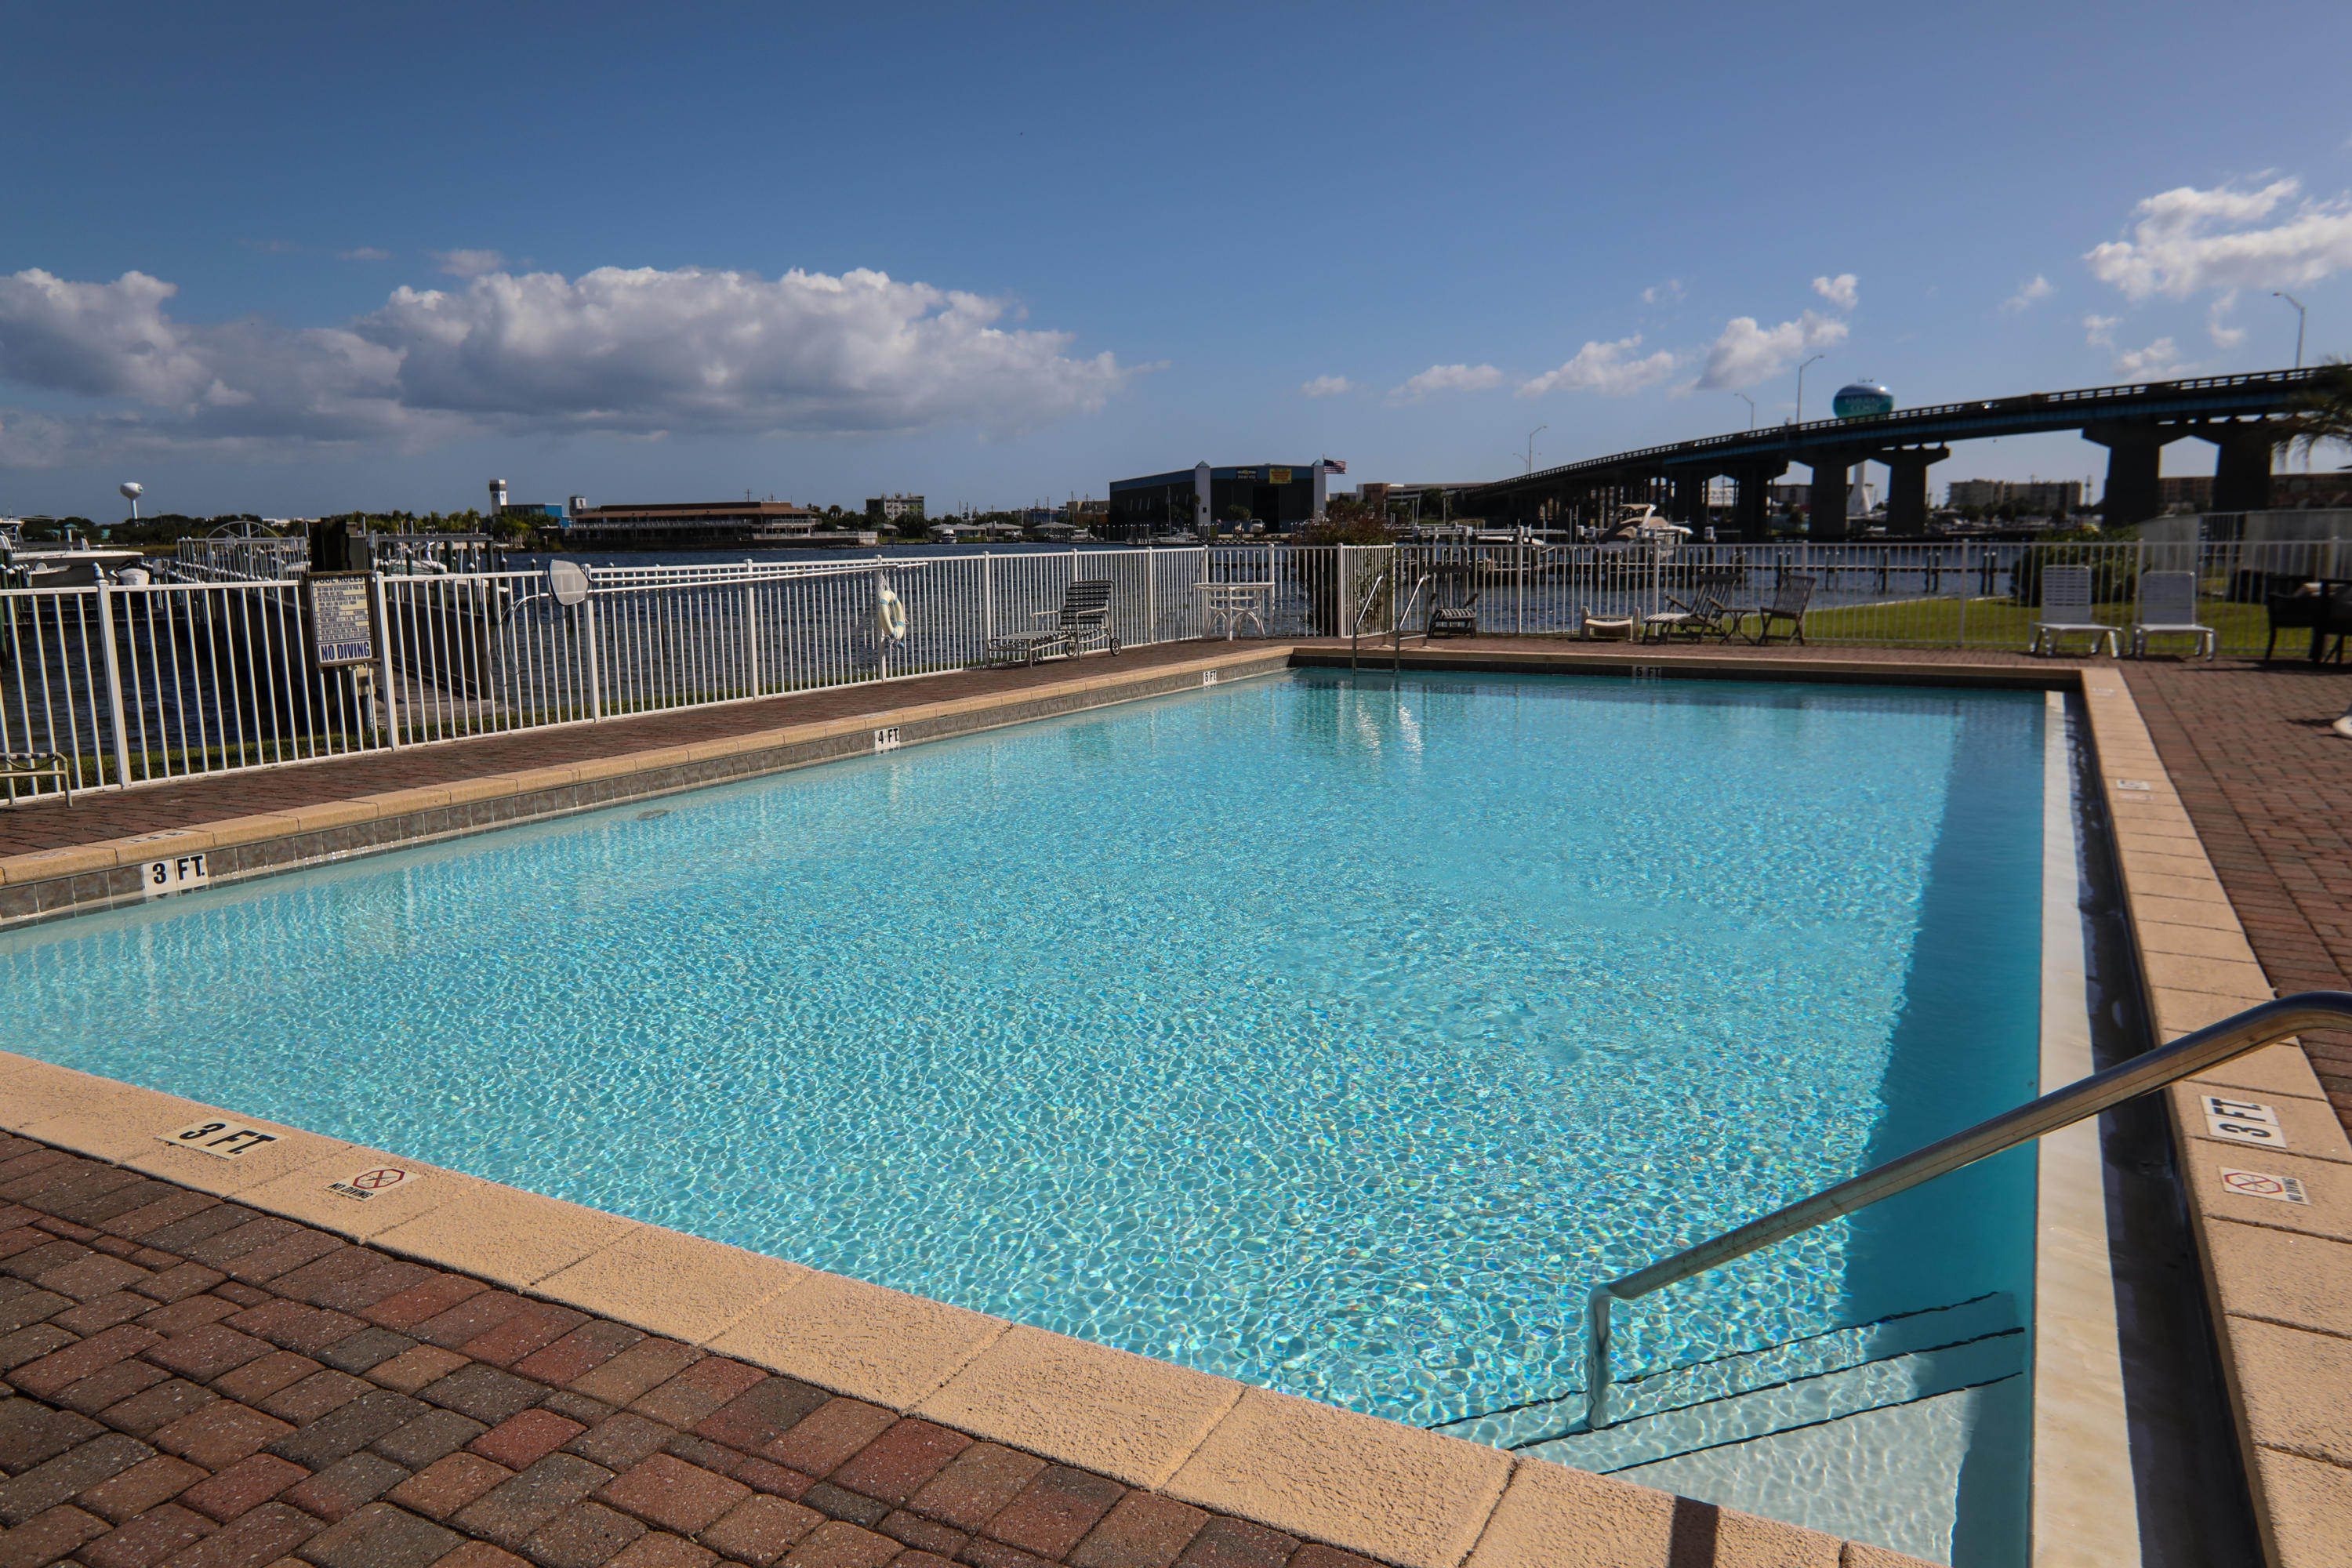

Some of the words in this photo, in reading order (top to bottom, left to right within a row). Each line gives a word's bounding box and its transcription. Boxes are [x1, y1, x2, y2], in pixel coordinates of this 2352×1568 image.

[321, 644, 335, 661] NO
[336, 641, 371, 659] DIVING
[1205, 672, 1209, 682] 5
[878, 731, 884, 744] 4
[887, 728, 899, 743] FT.
[152, 862, 167, 884] 3
[176, 855, 205, 880] FT.
[2210, 1098, 2267, 1122] FT.
[179, 1123, 227, 1140] 3
[205, 1130, 277, 1155] FT.
[2218, 1123, 2272, 1138] 3
[339, 1186, 374, 1200] DIVING
